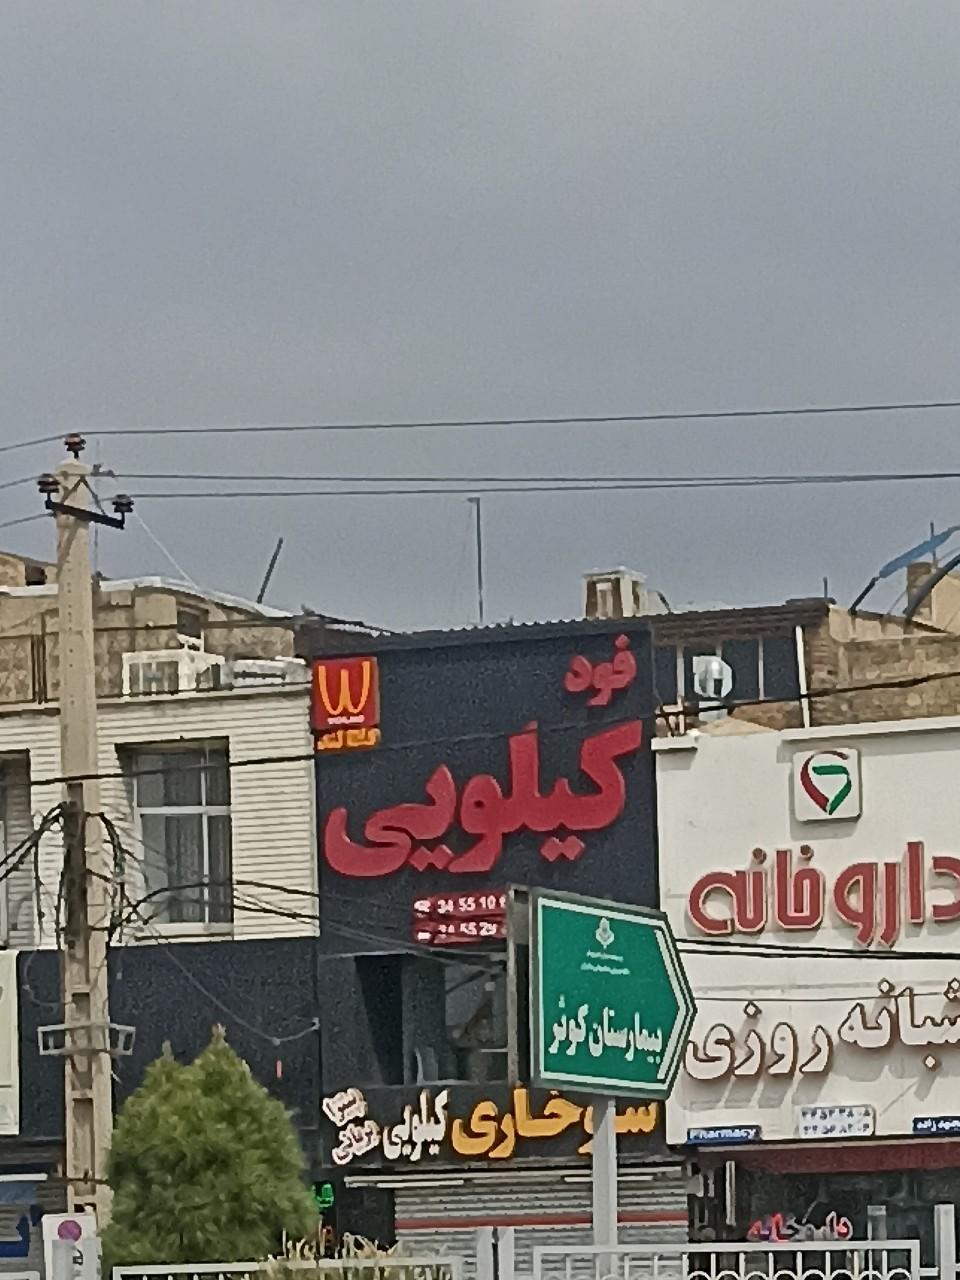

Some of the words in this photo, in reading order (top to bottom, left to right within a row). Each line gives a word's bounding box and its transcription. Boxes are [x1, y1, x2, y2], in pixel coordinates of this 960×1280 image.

[564, 633, 637, 706] فود
[324, 719, 643, 877] کیلویی
[549, 994, 589, 1056] کوثر
[588, 1006, 662, 1065] بیمارستان
[685, 1001, 834, 1080] روزی
[382, 1088, 450, 1162] کیلویی
